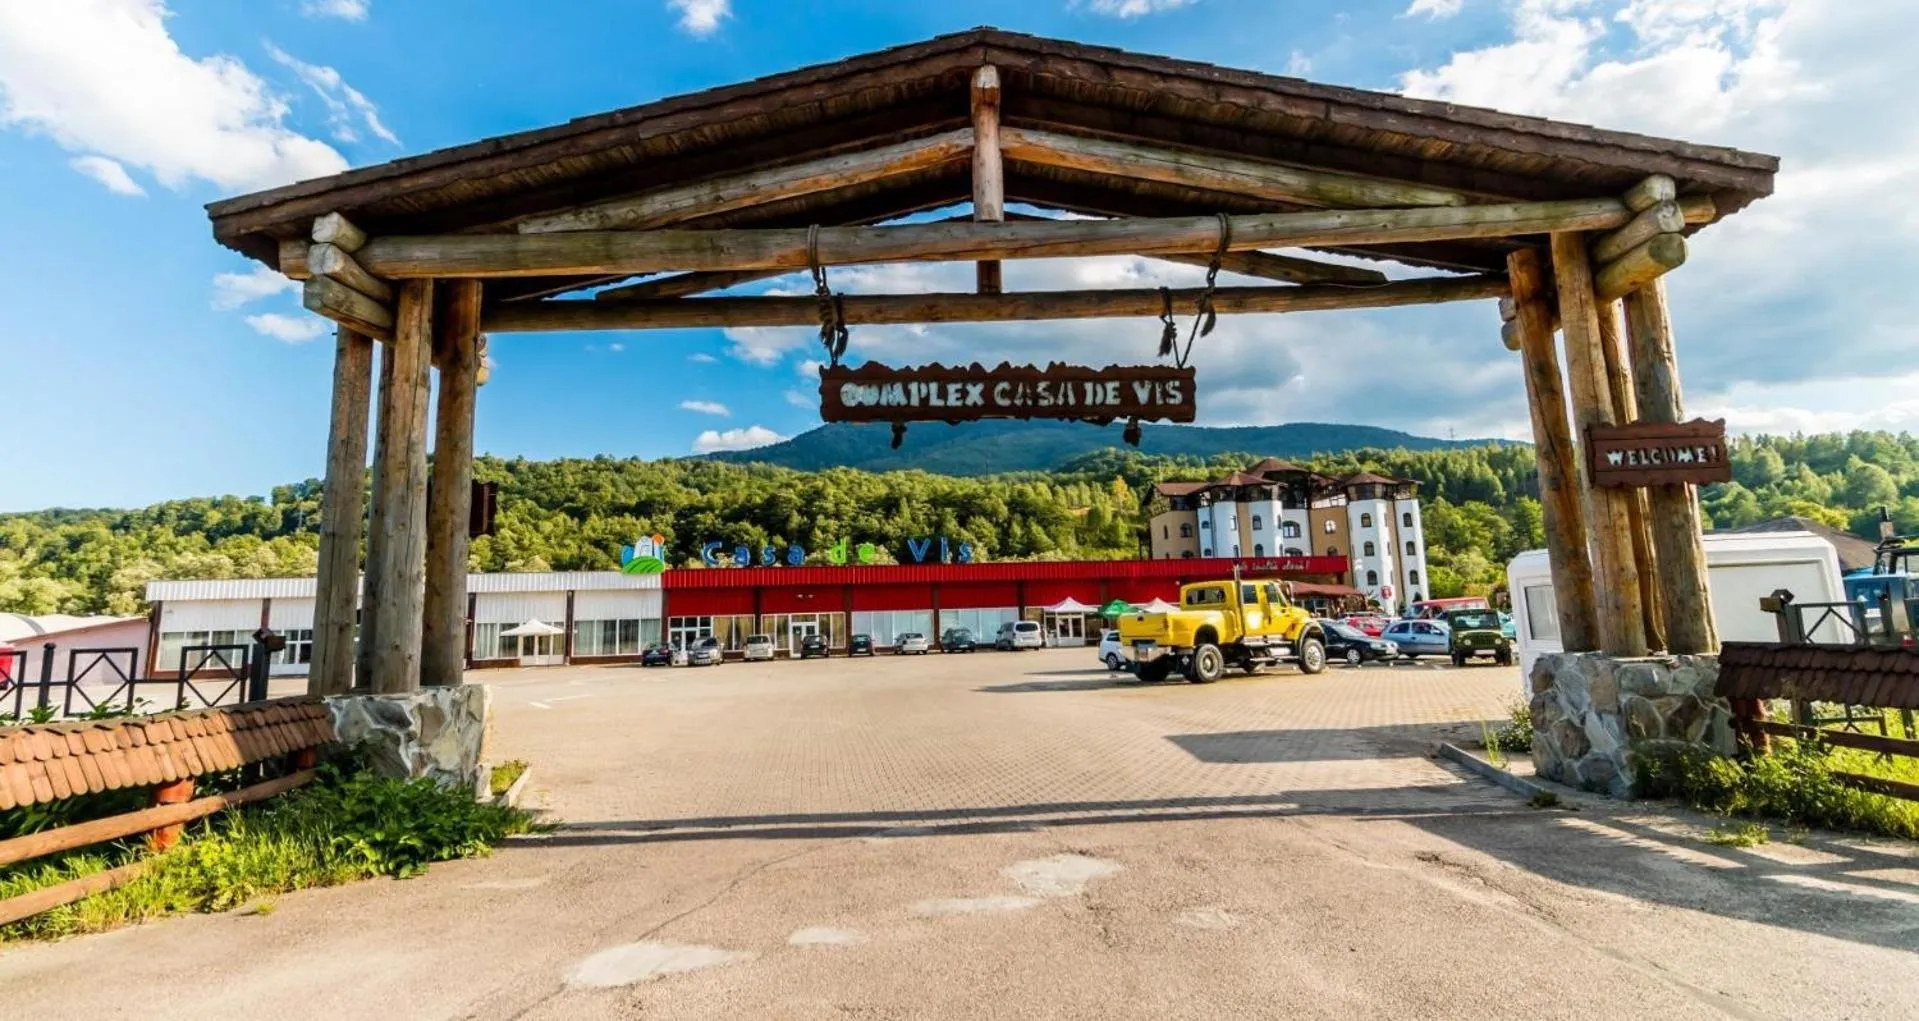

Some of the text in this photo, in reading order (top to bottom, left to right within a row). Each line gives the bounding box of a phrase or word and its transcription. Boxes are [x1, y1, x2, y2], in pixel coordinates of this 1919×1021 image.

[994, 380, 1075, 407] CASA
[1083, 381, 1119, 406] DE
[1132, 380, 1184, 406] VIS
[701, 536, 974, 566] Casa de Vis
